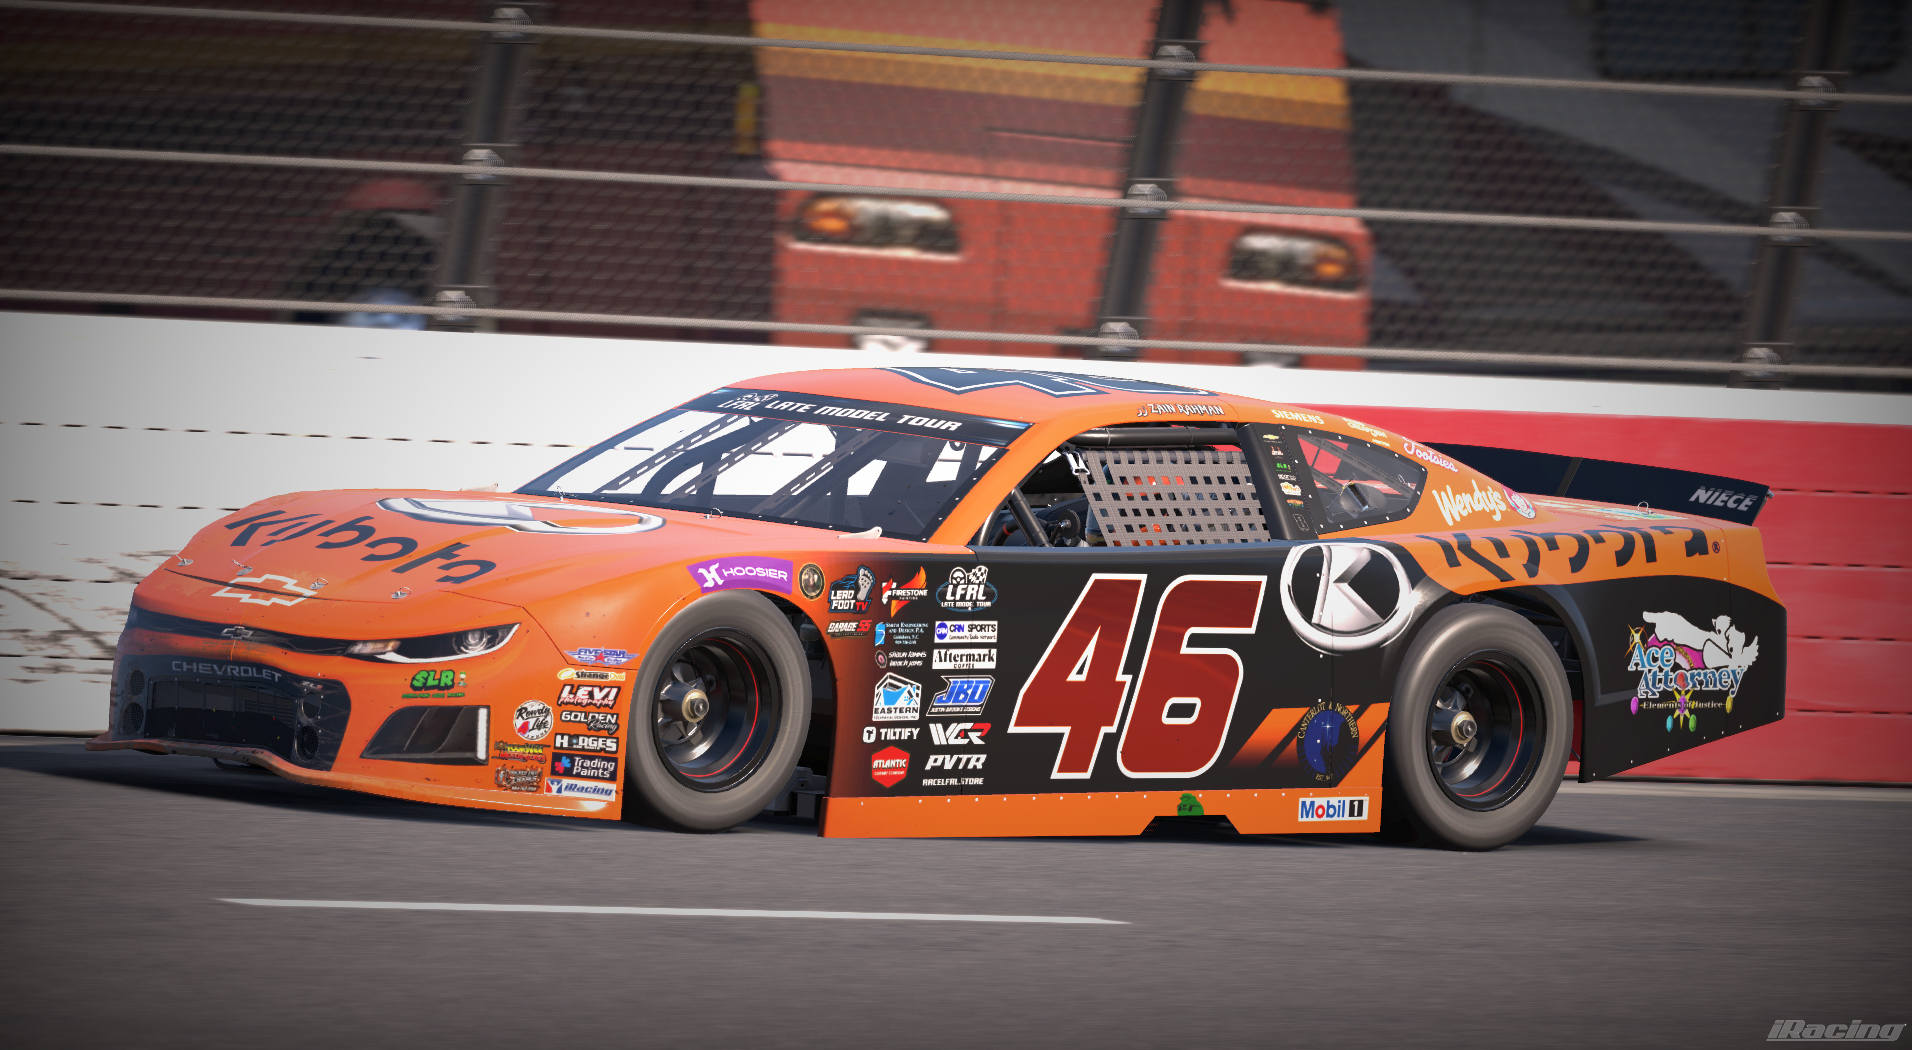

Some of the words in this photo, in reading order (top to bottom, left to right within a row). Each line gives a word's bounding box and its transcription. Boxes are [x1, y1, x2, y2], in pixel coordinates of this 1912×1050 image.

[764, 400, 817, 413] LATE
[813, 405, 891, 422] MODEL
[896, 414, 963, 432] TOUR
[1146, 403, 1177, 415] ZAIN
[1174, 403, 1225, 416] RAHMAN
[1271, 409, 1324, 424] SIEMENS
[1432, 479, 1507, 526] Wendy's
[1689, 485, 1758, 512] NIECE
[224, 510, 496, 584] Kubota
[1415, 524, 1710, 582] Kubota
[722, 566, 788, 581] HOOSIER
[892, 589, 928, 597] FIRESTONE
[945, 584, 987, 601] LFRL
[831, 600, 855, 610] FOOT
[856, 601, 869, 611] TV
[828, 622, 859, 632] GARAGE
[856, 619, 873, 632] 55
[949, 624, 965, 632] CRN
[967, 623, 997, 633] SPORTS
[934, 649, 995, 663] Aftermark
[1628, 643, 1676, 671] Ace
[171, 660, 282, 682] CHEVROLET
[1007, 573, 1268, 779] 46
[411, 670, 455, 689] SLR
[1638, 667, 1747, 698] Attorney
[561, 685, 619, 700] LEVI
[934, 679, 992, 706] JBD
[1643, 700, 1681, 709] Elements
[1683, 700, 1692, 709] of
[516, 706, 550, 720] Rowdy
[561, 712, 617, 723] GOLDEN
[1298, 701, 1326, 739] CANTERLOT
[1334, 702, 1359, 739] NORTHERN
[529, 717, 550, 732] Life
[587, 719, 617, 733] Racing
[879, 728, 921, 741] TILTIFY
[573, 757, 616, 772] Trading
[873, 759, 907, 770] ATLANTIC
[924, 754, 988, 770] PVTR
[573, 766, 610, 778] Paints
[563, 782, 615, 797] iRacing
[1300, 800, 1346, 819] Mobil
